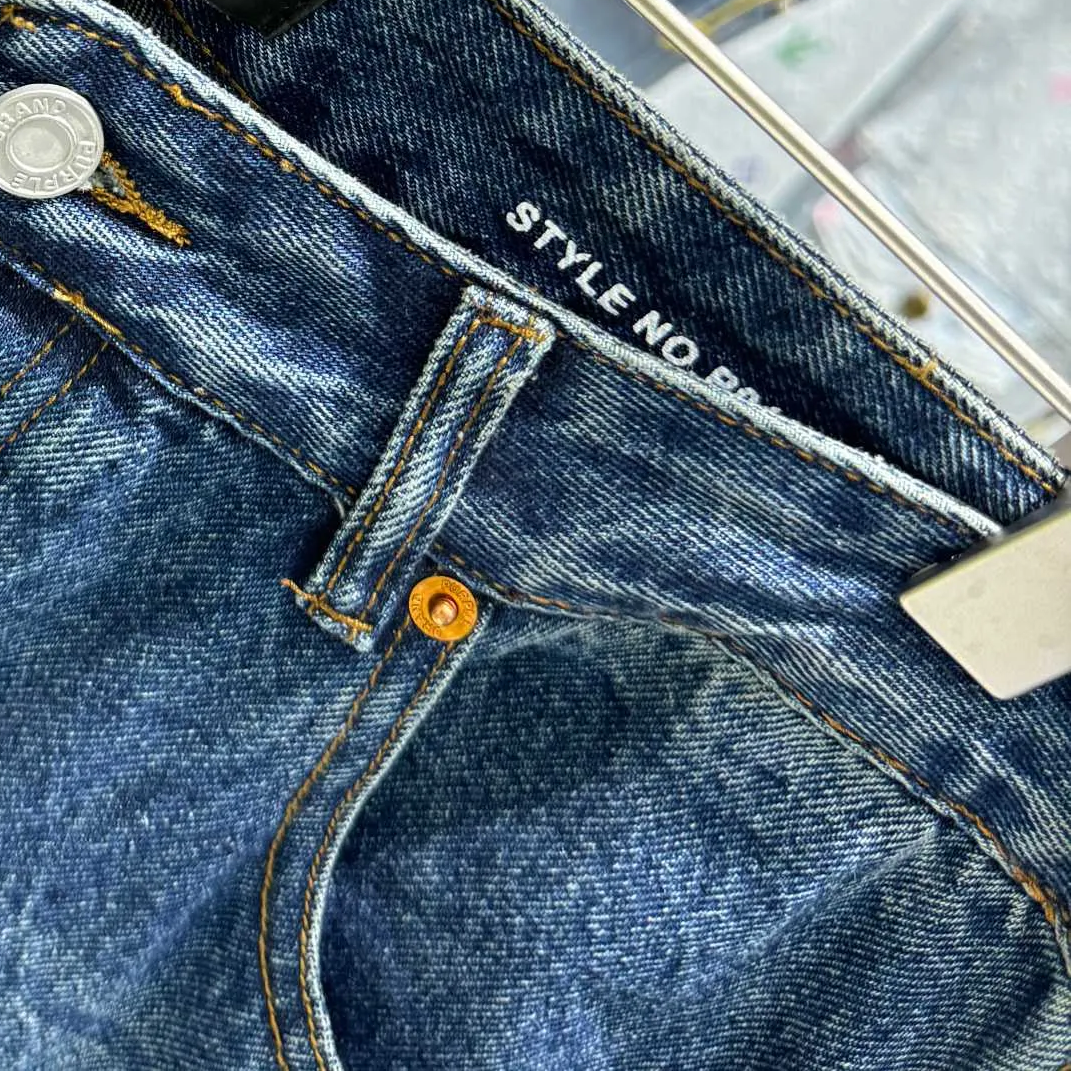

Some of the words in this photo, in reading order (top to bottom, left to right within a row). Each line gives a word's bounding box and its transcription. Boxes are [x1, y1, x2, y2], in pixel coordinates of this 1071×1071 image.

[10, 140, 96, 193] PURPLE
[505, 201, 636, 316] STYLE
[632, 309, 700, 367] NO
